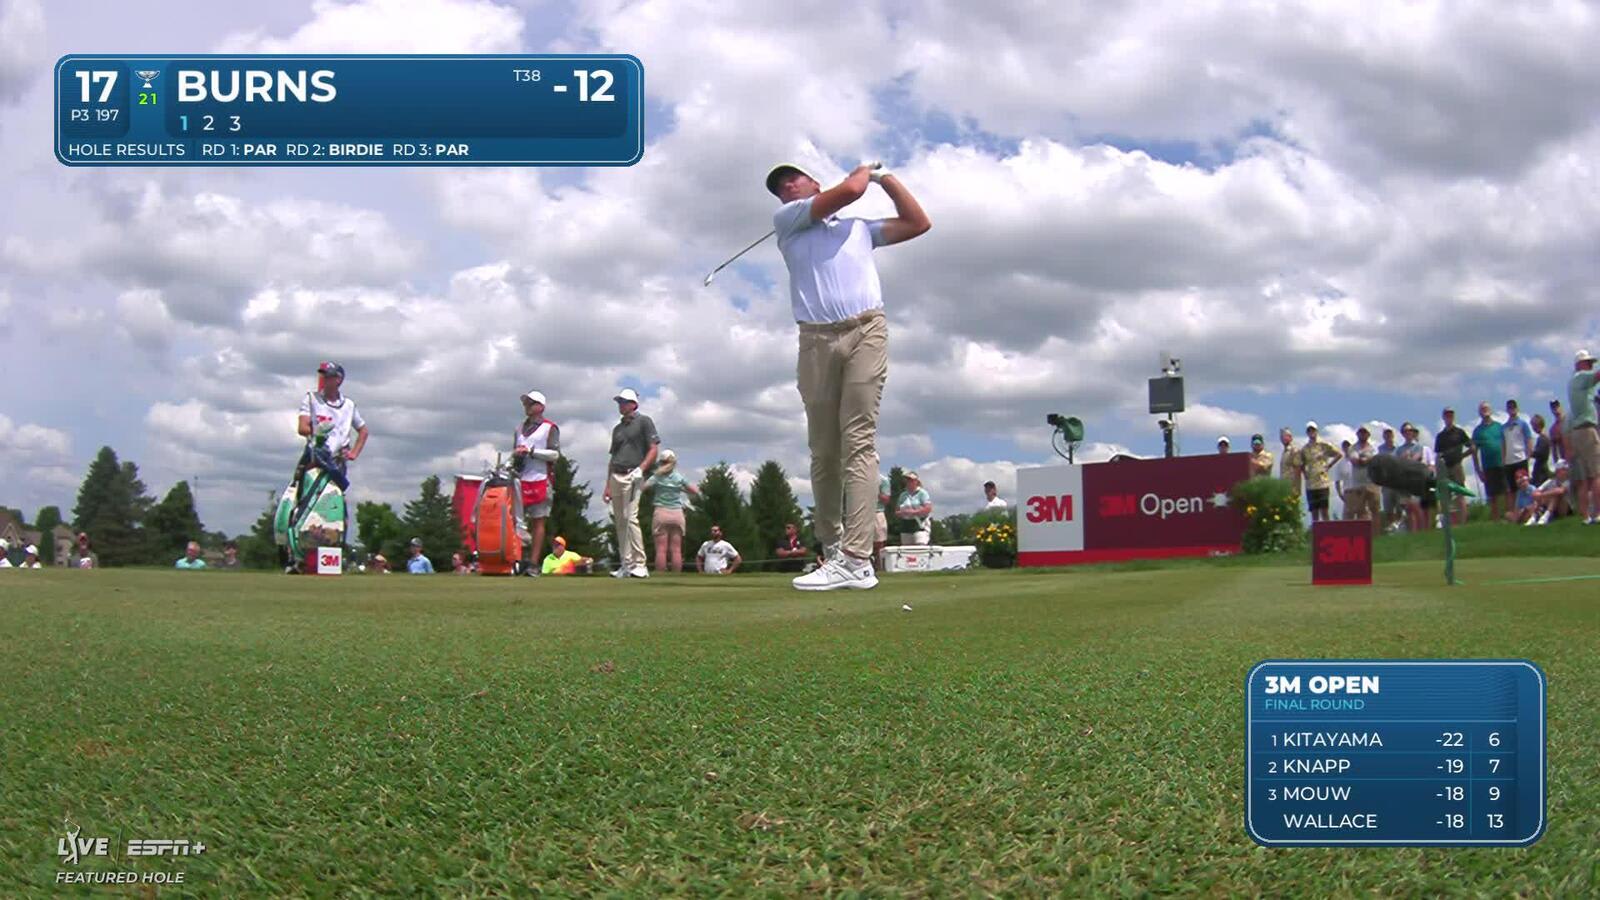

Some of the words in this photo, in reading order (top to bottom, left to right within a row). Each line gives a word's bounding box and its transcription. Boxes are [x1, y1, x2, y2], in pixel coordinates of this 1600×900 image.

[1026, 495, 1073, 523] 3M
[1140, 492, 1203, 518] Open
[321, 554, 340, 567] 3M
[1319, 535, 1366, 563] 3M
